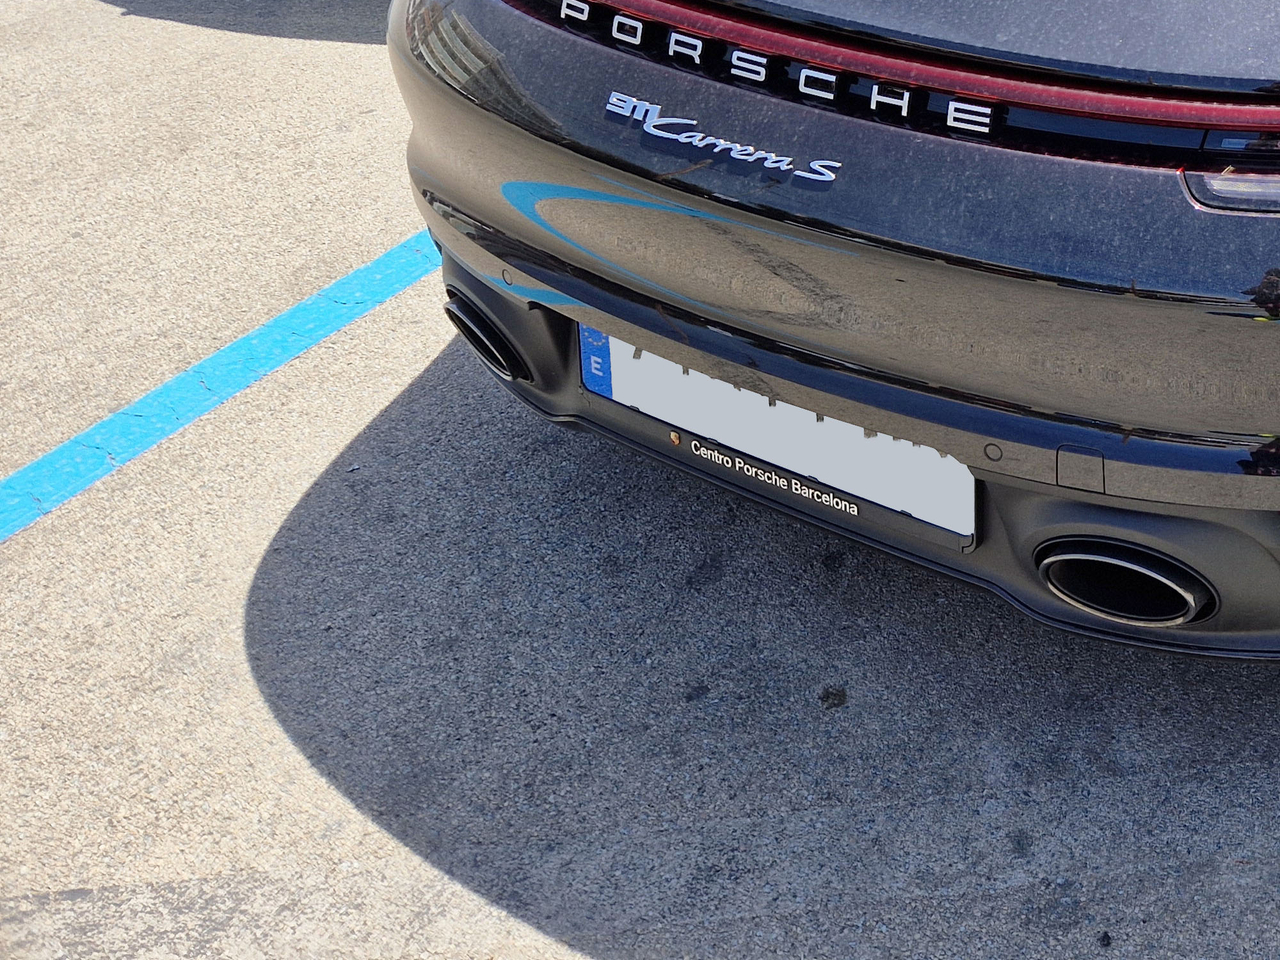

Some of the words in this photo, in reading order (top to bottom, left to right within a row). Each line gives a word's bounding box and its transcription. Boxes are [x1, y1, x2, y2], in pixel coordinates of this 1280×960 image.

[605, 91, 662, 122] 911
[643, 117, 793, 171] Carrera
[793, 160, 843, 182] S
[591, 355, 604, 376] E
[690, 440, 732, 468] Centro
[735, 457, 788, 490] Porsche
[791, 479, 859, 516] Barcelona
